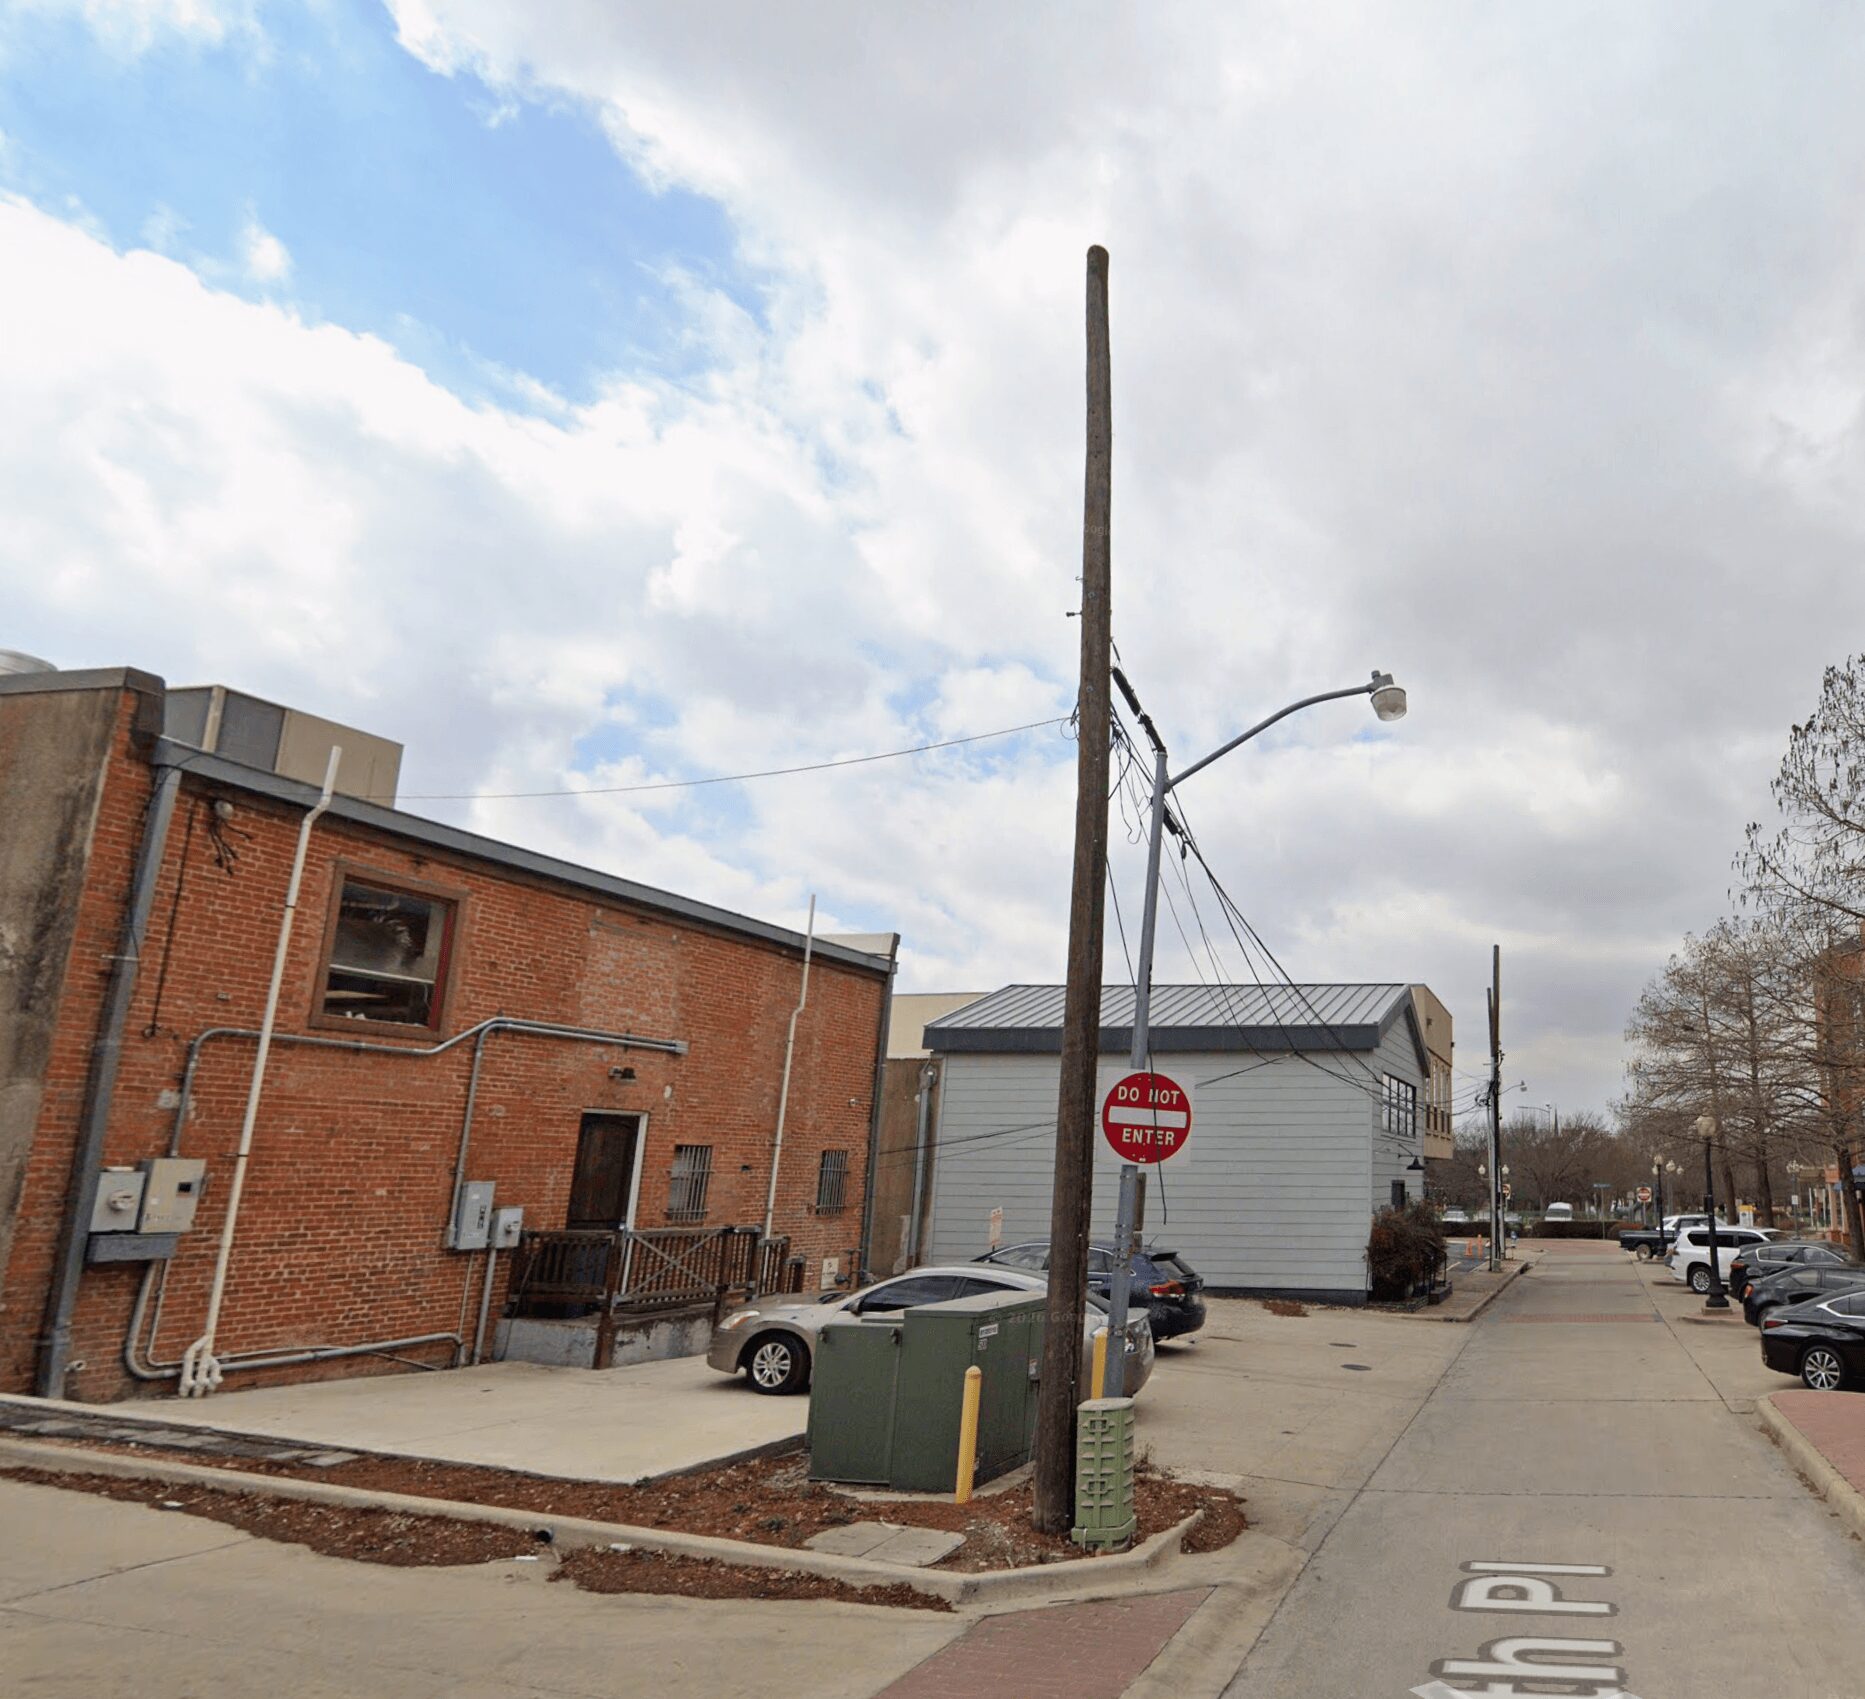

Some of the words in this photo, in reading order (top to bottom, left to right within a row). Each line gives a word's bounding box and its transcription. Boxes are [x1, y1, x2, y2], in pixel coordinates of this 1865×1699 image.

[1117, 1085, 1140, 1102] DO
[1148, 1088, 1180, 1105] NOT
[1121, 1127, 1175, 1146] ENTER
